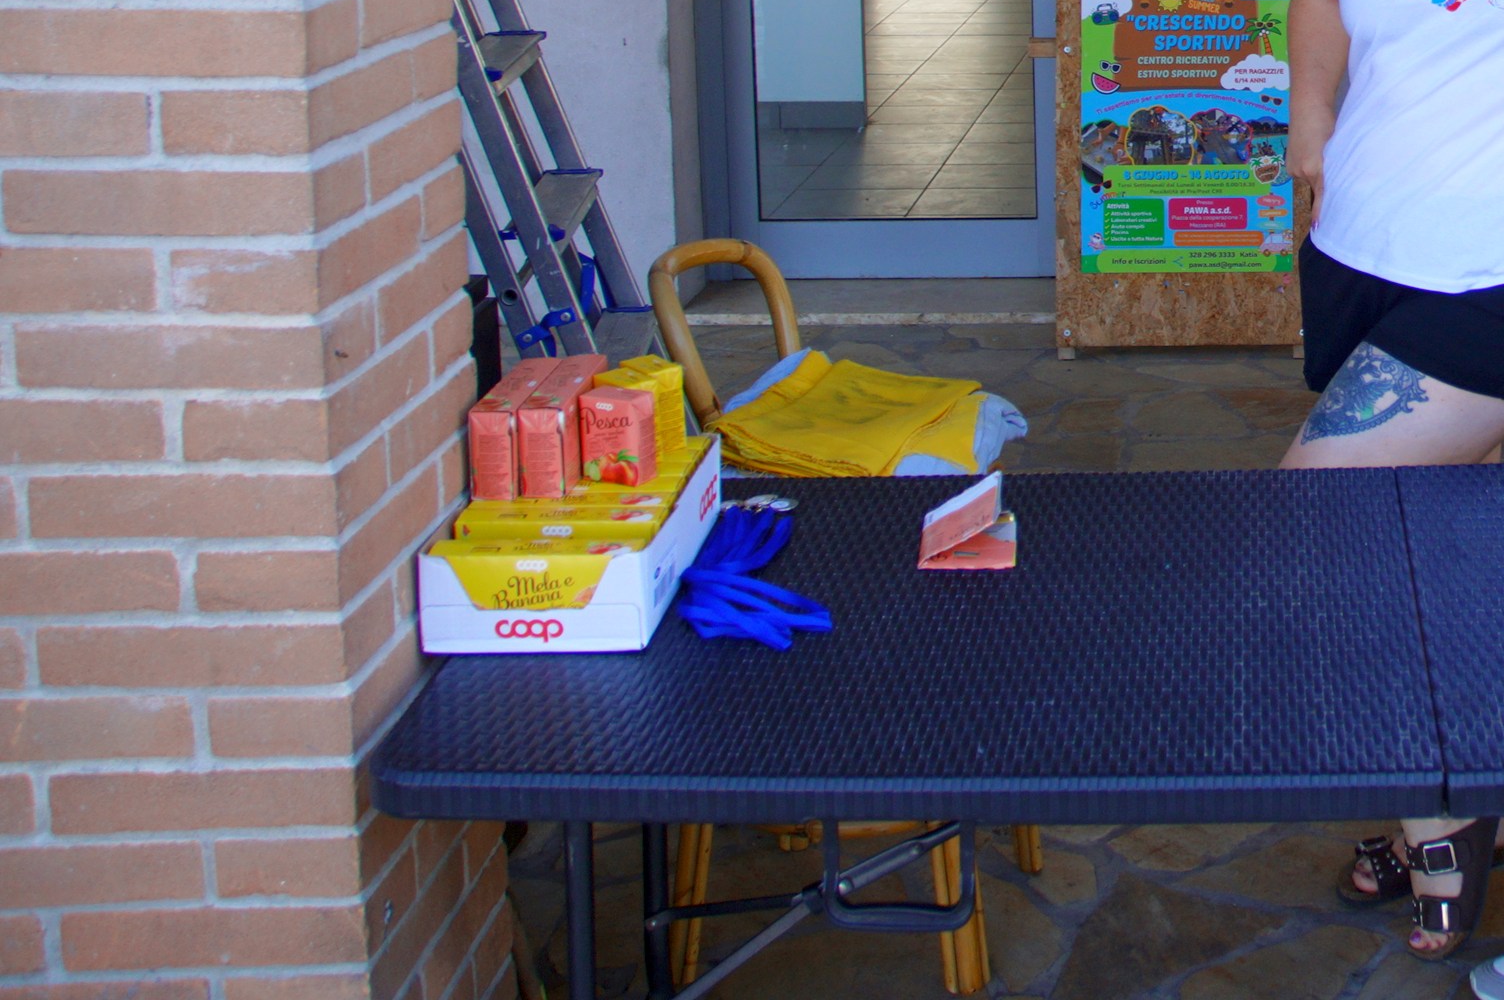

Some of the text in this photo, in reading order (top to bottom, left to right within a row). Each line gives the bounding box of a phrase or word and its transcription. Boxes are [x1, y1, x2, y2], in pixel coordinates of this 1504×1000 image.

[1188, 0, 1220, 14] SUMMER
[1126, 13, 1246, 31] "CRESCENDO
[1154, 33, 1250, 51] SPORTIVI"
[1137, 56, 1230, 65] CENTRO RICREATIVO
[1137, 69, 1217, 78] ESTIVO SPORTIVO
[1133, 169, 1179, 180] GIUGNO
[1188, 169, 1202, 180] 14
[1203, 169, 1250, 180] AGOSTO
[1188, 261, 1262, 269] pawa.asd@gmail.com
[579, 407, 633, 435] Pesca
[507, 572, 575, 597] Mela e
[492, 589, 564, 610] Banana
[494, 619, 564, 643] coop
